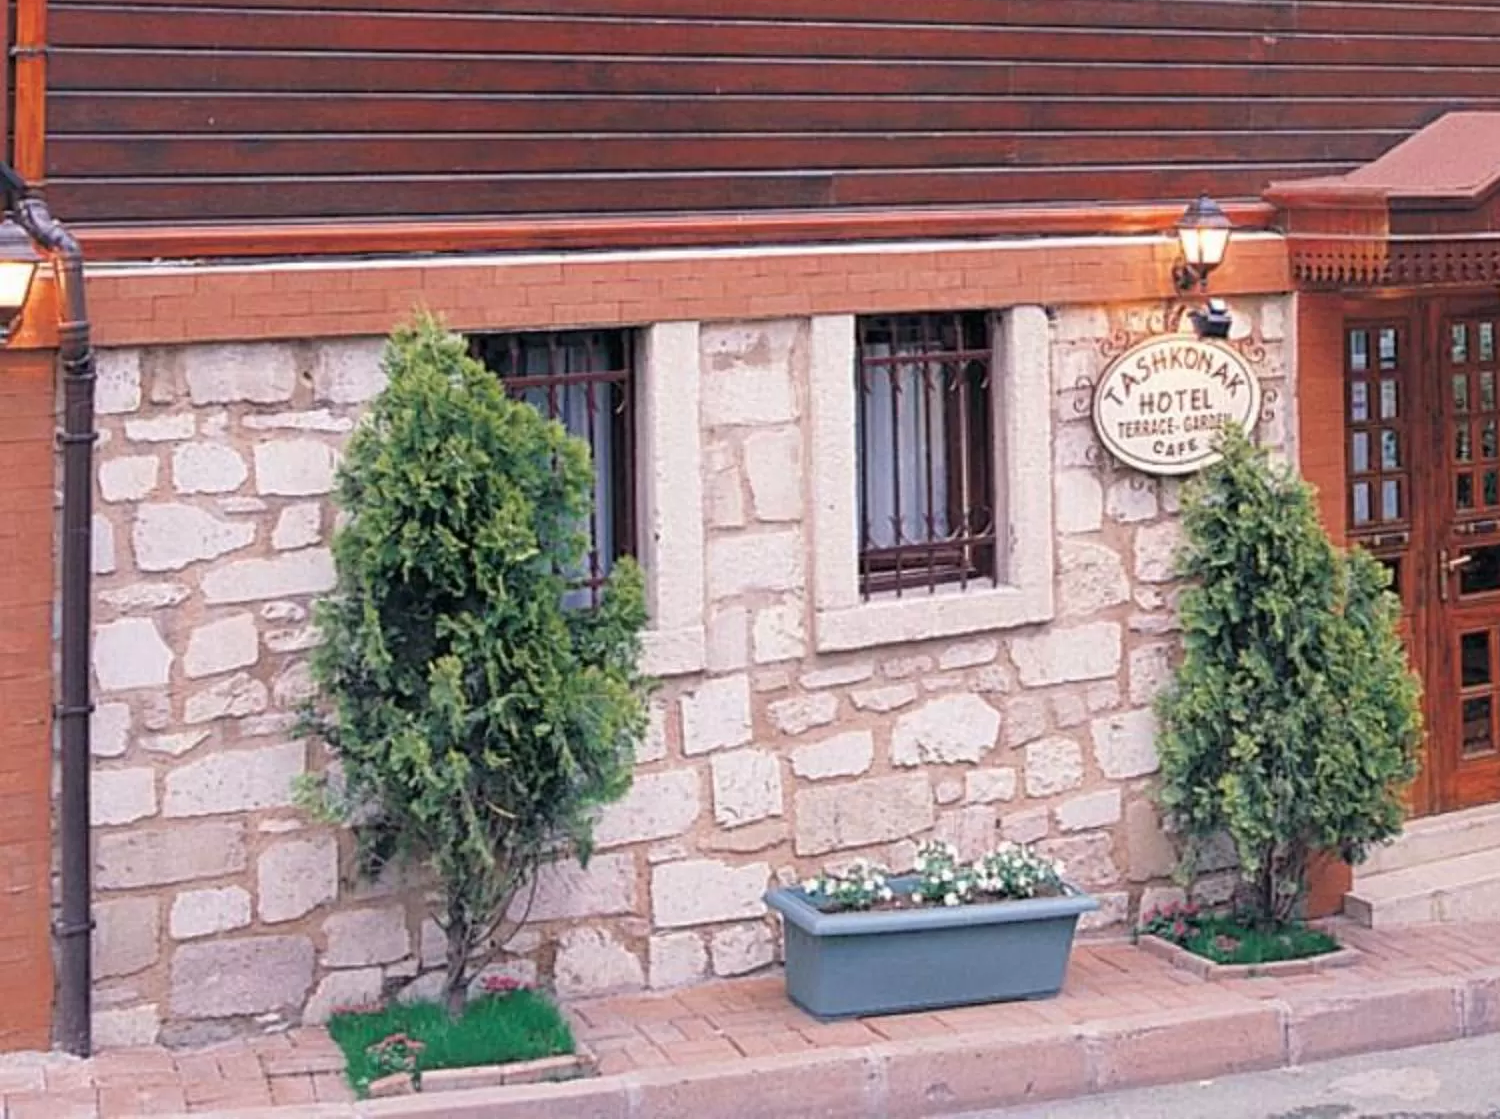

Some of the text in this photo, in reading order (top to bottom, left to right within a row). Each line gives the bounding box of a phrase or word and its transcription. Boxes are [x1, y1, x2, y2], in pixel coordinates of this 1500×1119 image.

[1104, 346, 1245, 406] TASHKONAK
[1139, 388, 1213, 415] HOTEL
[1152, 438, 1199, 457] CAFE
